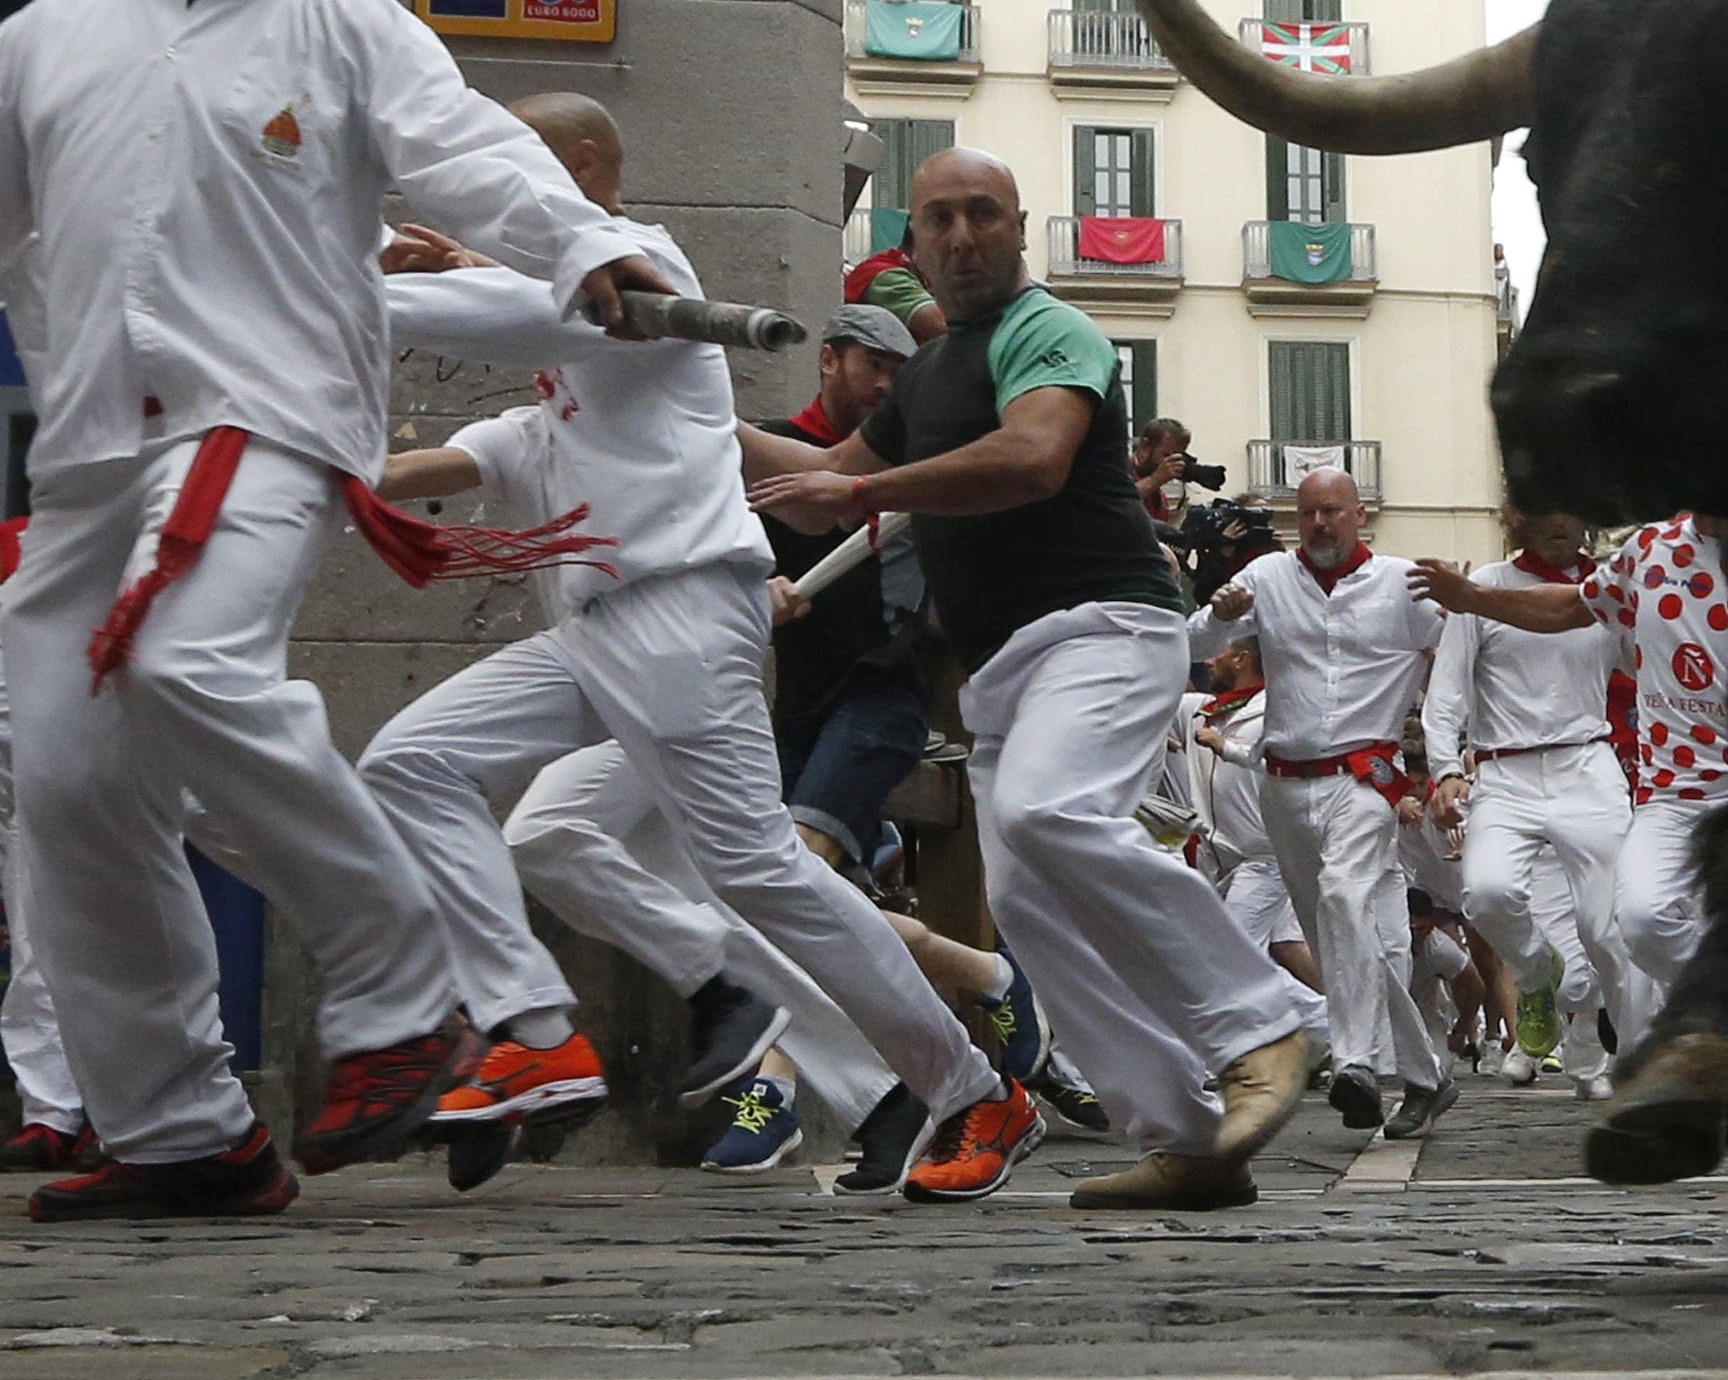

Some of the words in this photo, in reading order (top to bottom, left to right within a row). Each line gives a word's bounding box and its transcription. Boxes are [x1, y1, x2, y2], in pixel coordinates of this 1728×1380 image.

[527, 5, 560, 17] EURO
[561, 6, 597, 19] 6000
[1681, 647, 1705, 685] Ñ
